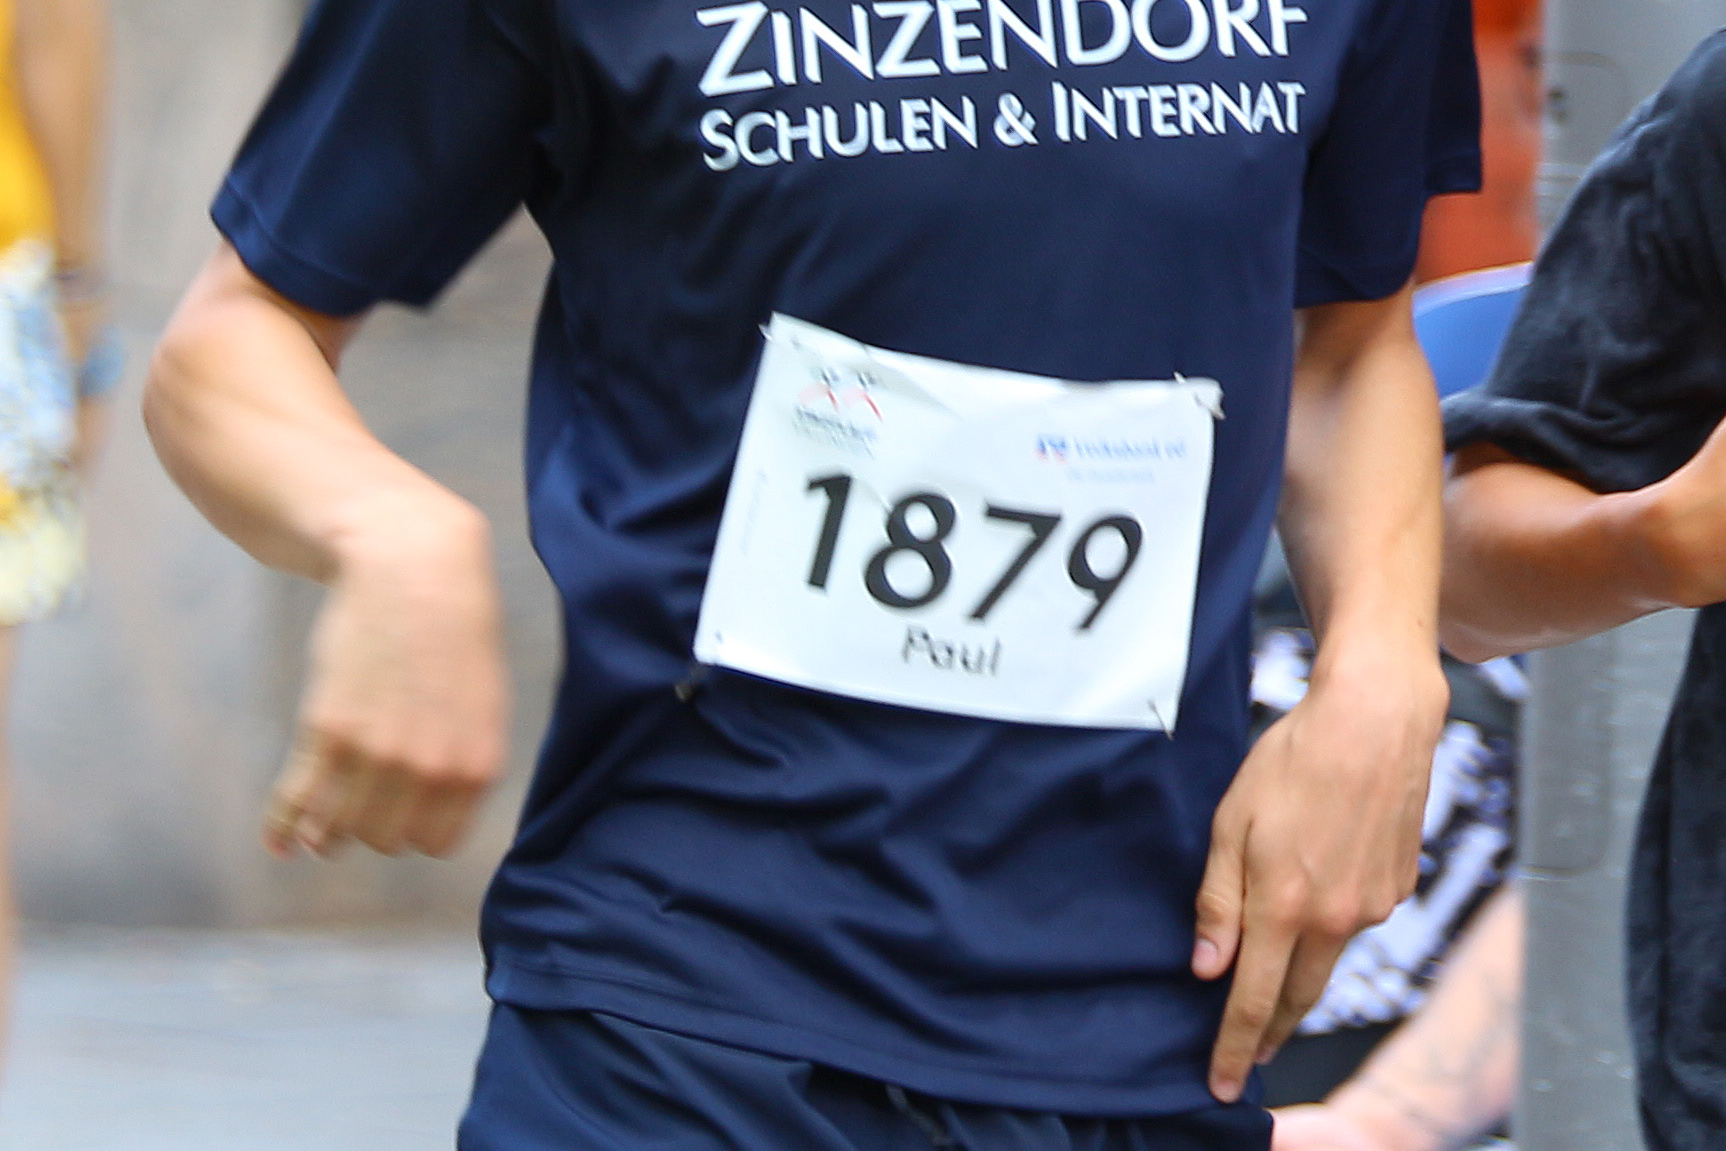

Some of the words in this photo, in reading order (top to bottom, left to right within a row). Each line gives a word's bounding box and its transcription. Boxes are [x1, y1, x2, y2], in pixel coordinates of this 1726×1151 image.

[702, 96, 978, 170] SCHULEN
[994, 92, 1038, 146] &
[1053, 81, 1305, 141] INTERNAT
[805, 474, 1144, 635] 1879
[901, 625, 1001, 676] Paul
